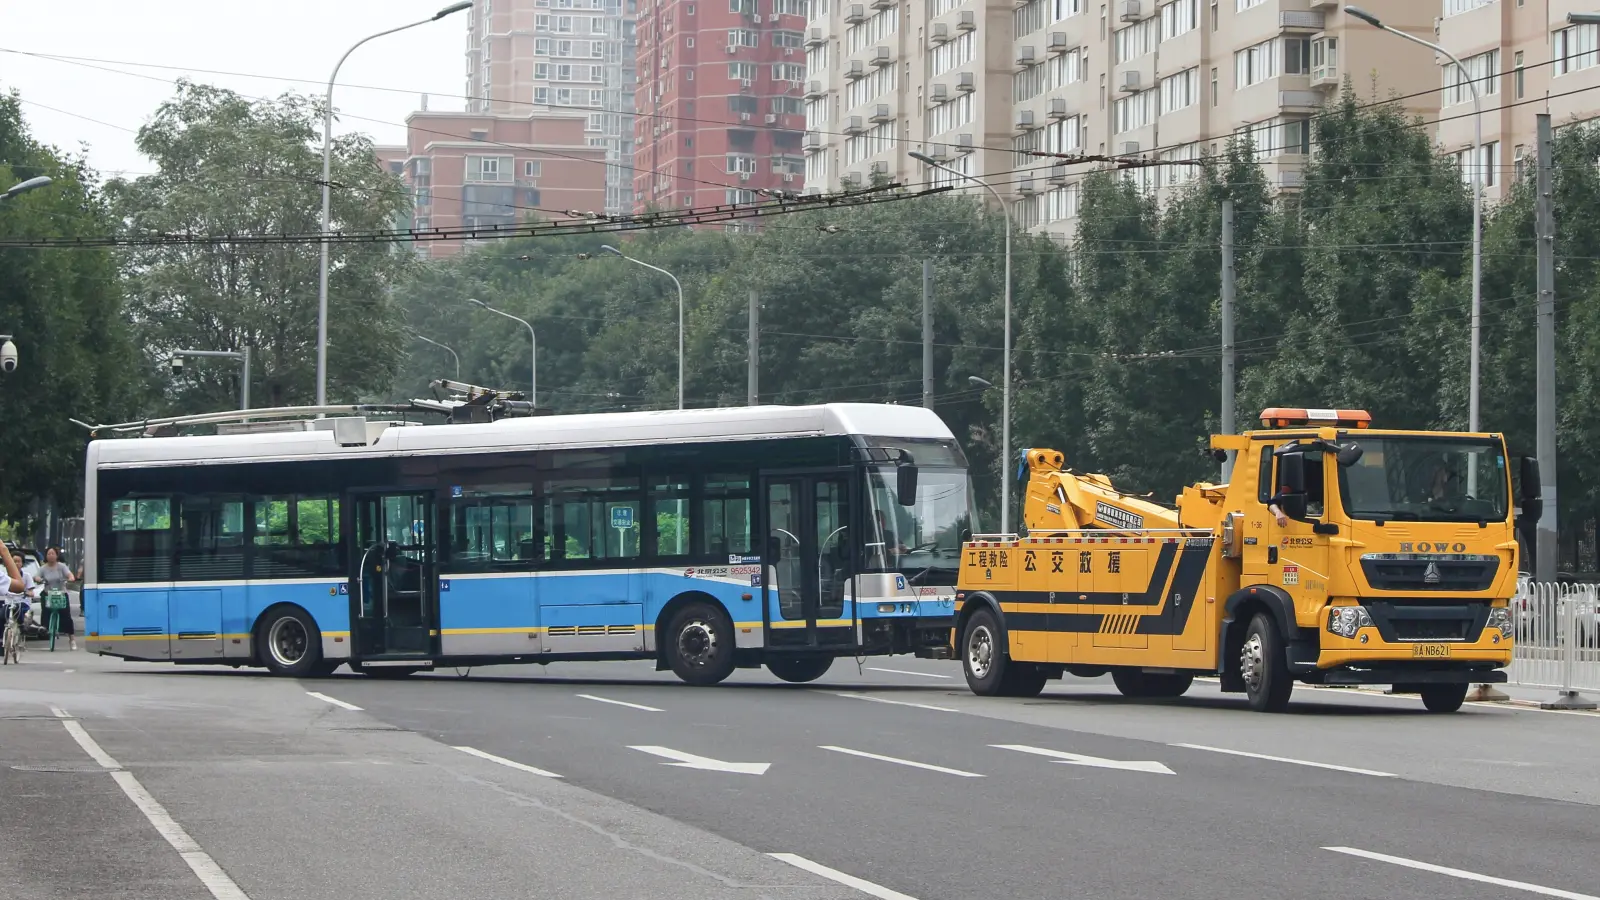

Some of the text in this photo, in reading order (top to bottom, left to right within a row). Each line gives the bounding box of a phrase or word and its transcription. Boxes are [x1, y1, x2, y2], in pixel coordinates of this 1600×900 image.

[1399, 542, 1466, 553] HOWO
[968, 551, 1008, 568] 工程救险
[1024, 550, 1121, 574] 公交救援
[730, 566, 760, 575] 9525342
